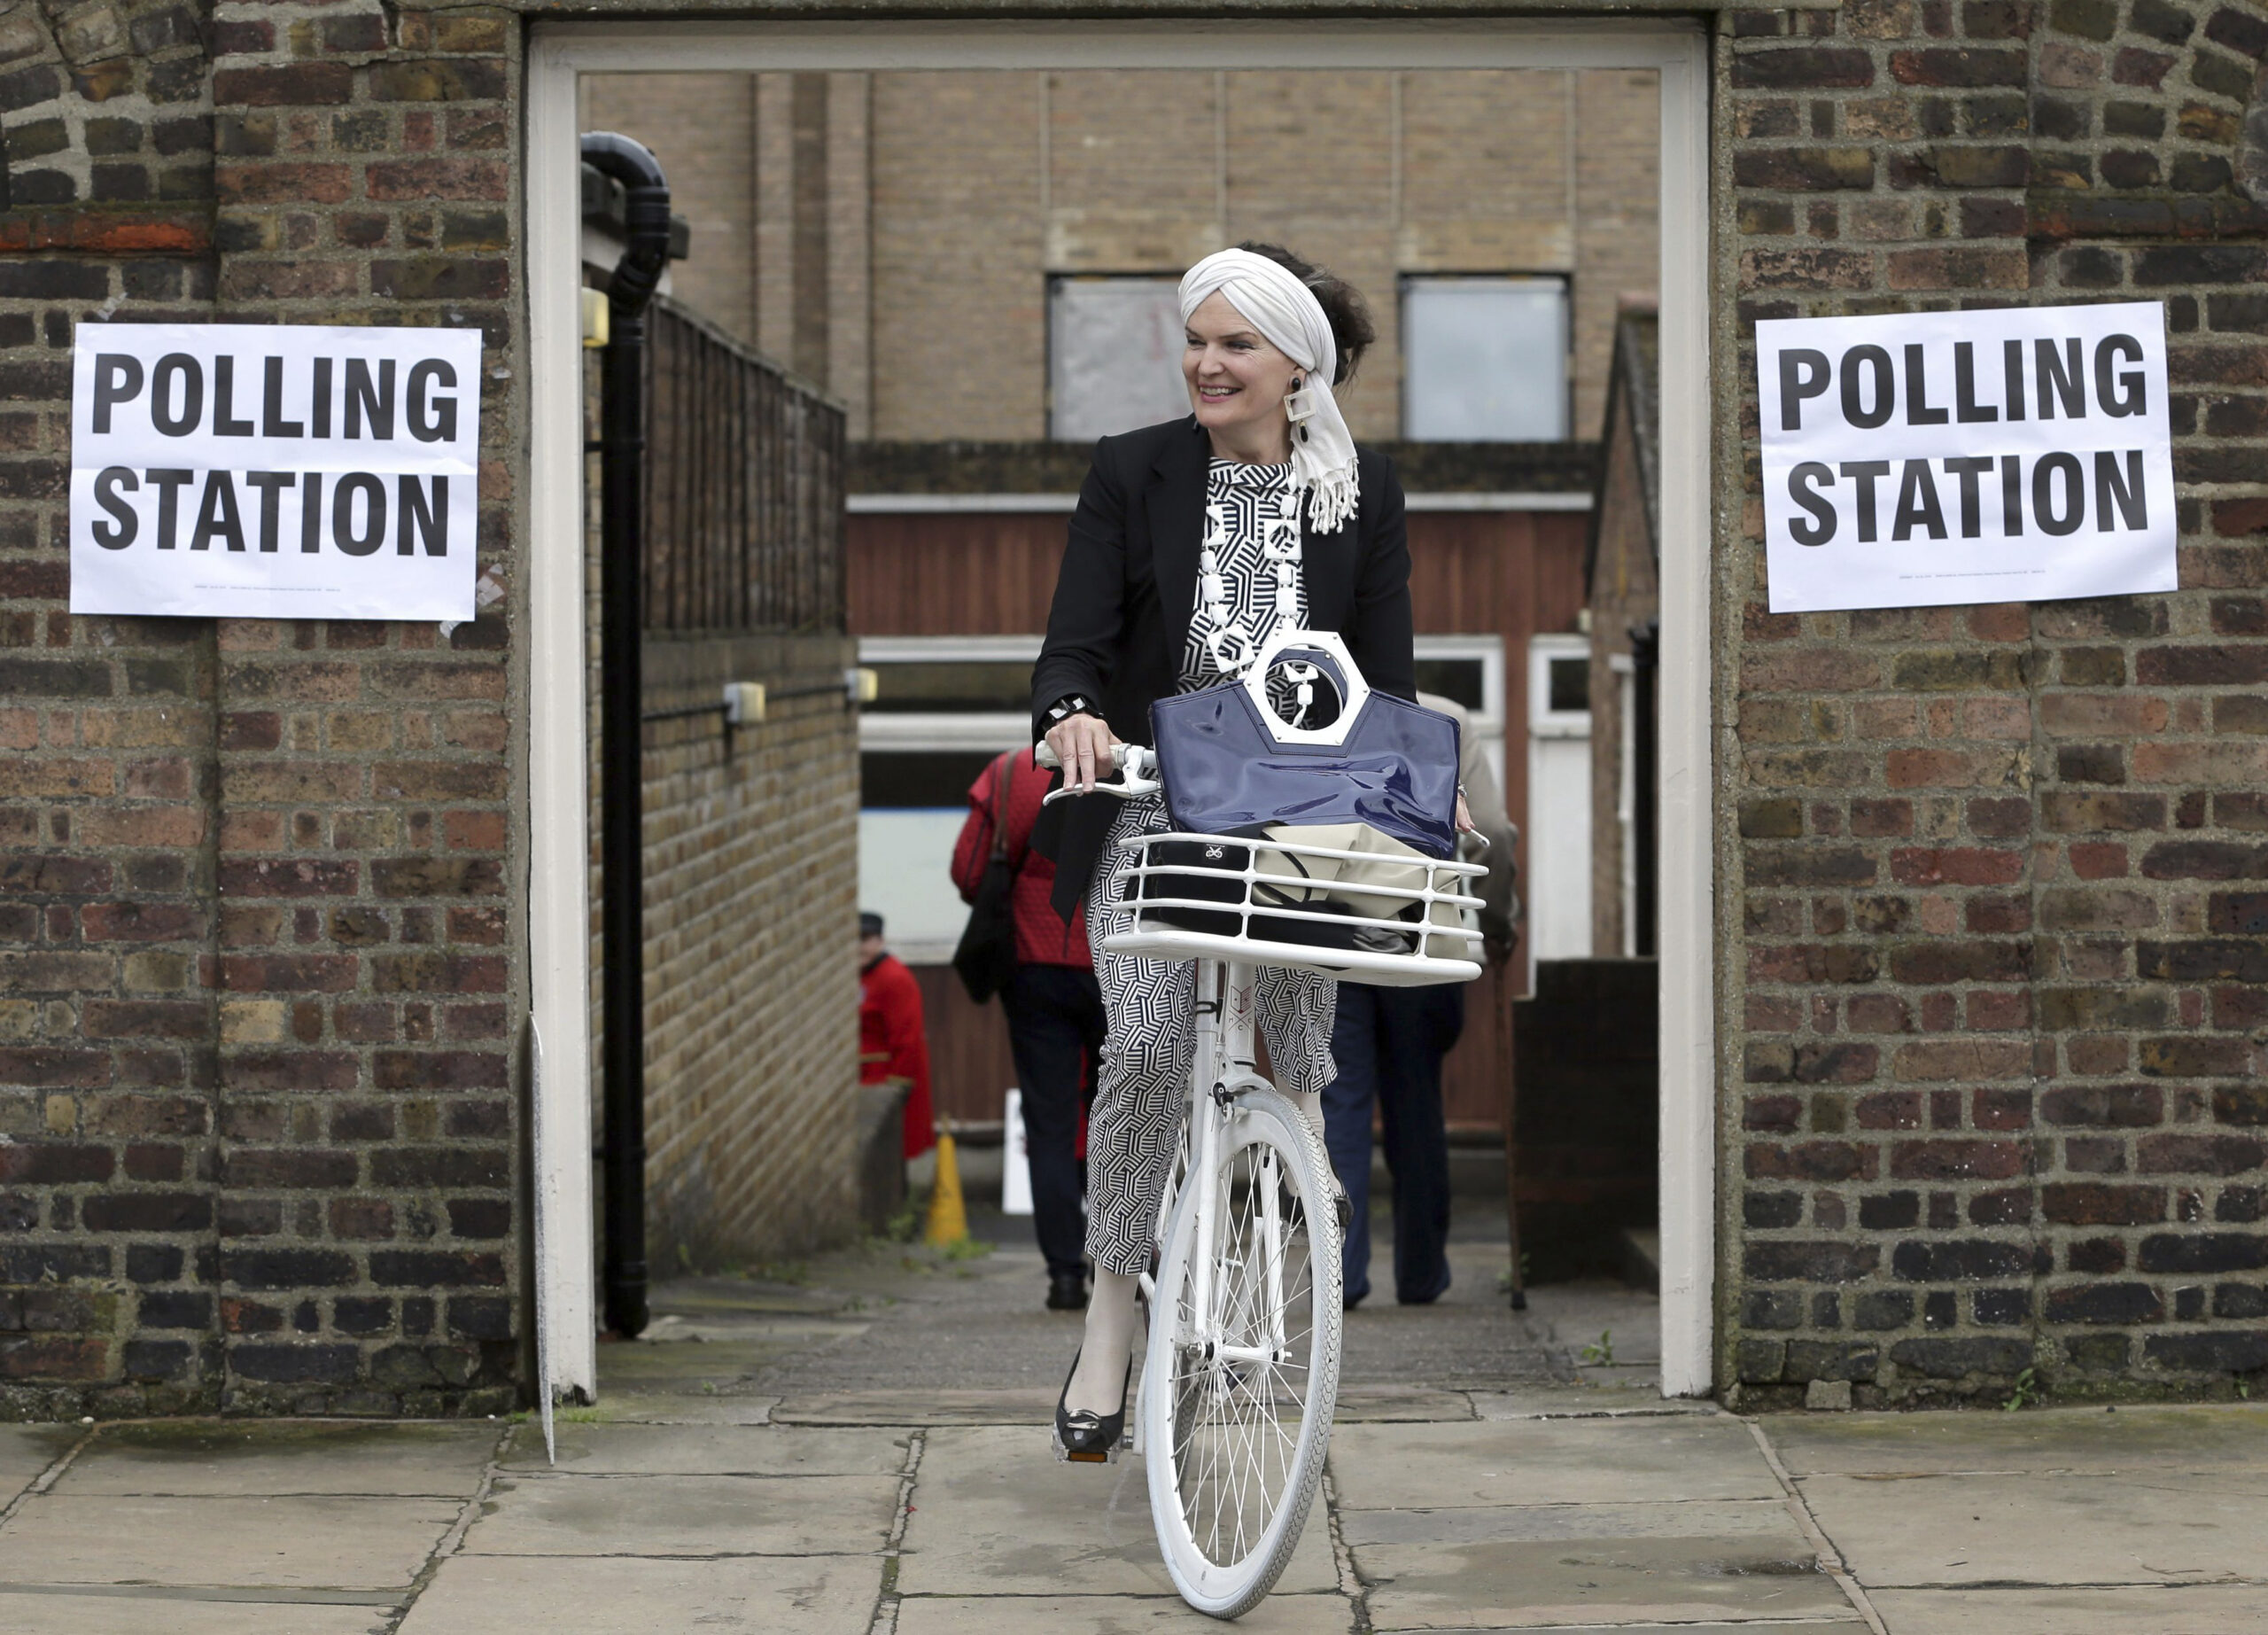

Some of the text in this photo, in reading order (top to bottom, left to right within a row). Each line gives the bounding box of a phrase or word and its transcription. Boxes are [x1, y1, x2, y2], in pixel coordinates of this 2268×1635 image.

[92, 352, 458, 443] POLLING
[1778, 333, 2147, 431] POLLING
[91, 465, 449, 557] STATION
[1788, 449, 2148, 547] STATION
